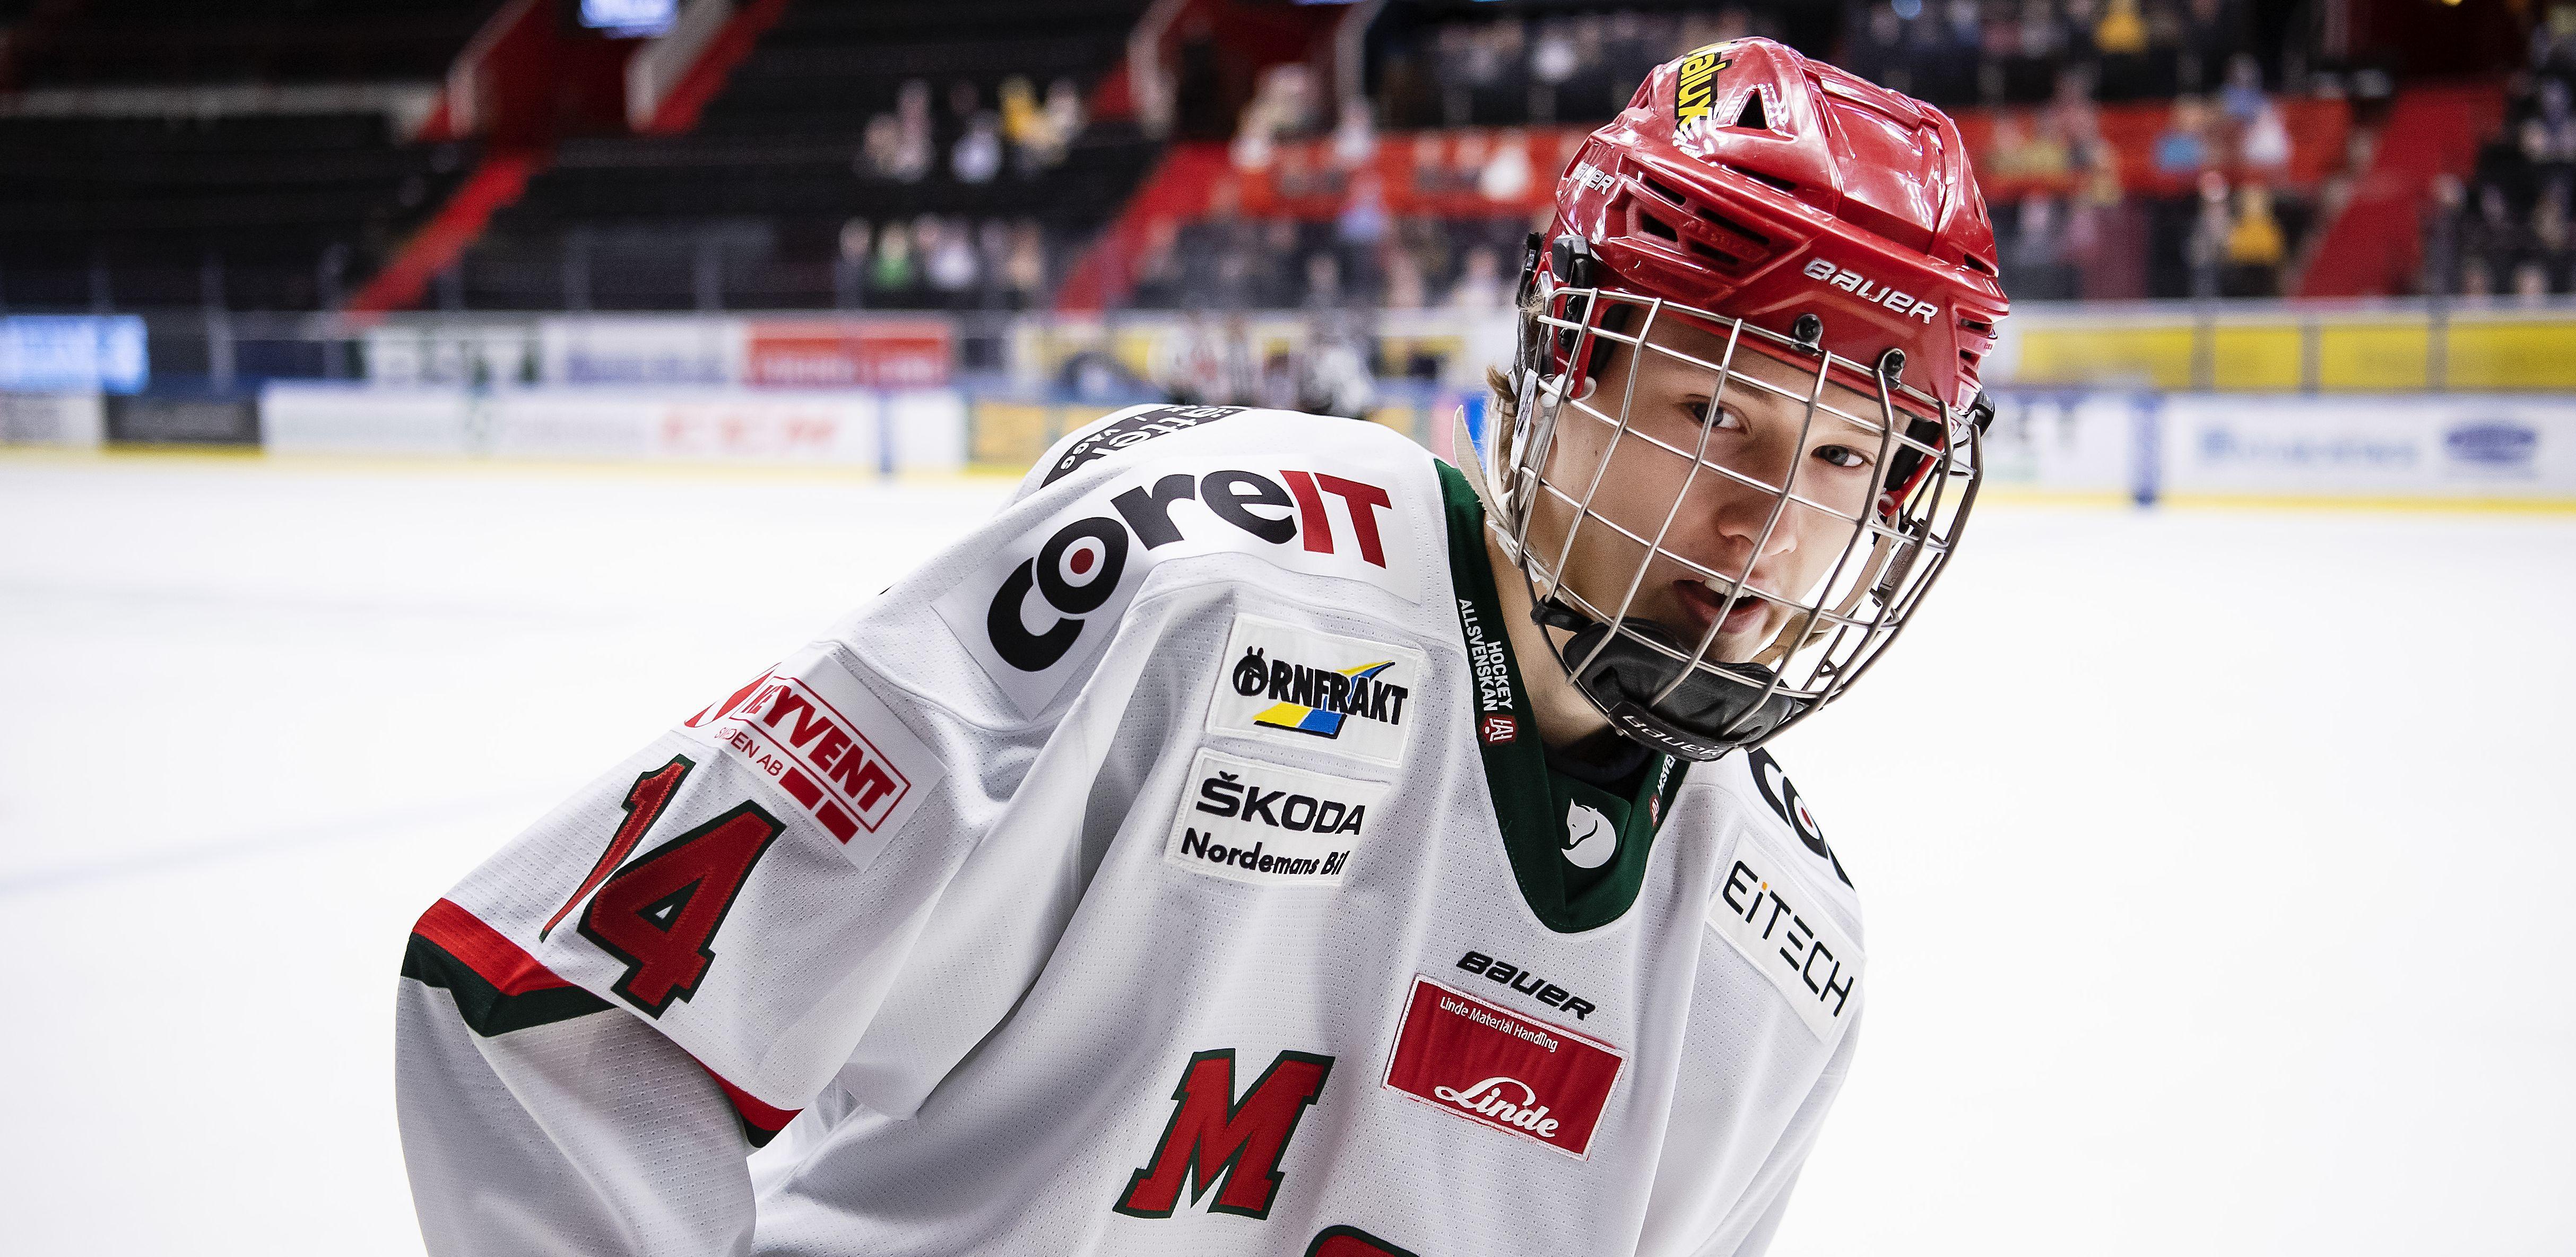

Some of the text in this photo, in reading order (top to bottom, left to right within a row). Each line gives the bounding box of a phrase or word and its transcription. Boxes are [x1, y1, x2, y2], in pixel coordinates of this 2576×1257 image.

[1678, 46, 1727, 135] alux
[1233, 646, 1408, 725] ÖRNFRAKT
[1459, 599, 1498, 711] ALLSVENSKAN
[1487, 640, 1513, 710] HOCKEY
[756, 754, 784, 776] AB
[1195, 770, 1366, 835] ŠKODA
[1181, 827, 1350, 875] Nordemans Bil
[540, 753, 787, 1020] 14
[1439, 996, 1558, 1053] Linde Material Handling
[1113, 1048, 1335, 1220] M
[1434, 1076, 1559, 1139] Linde
